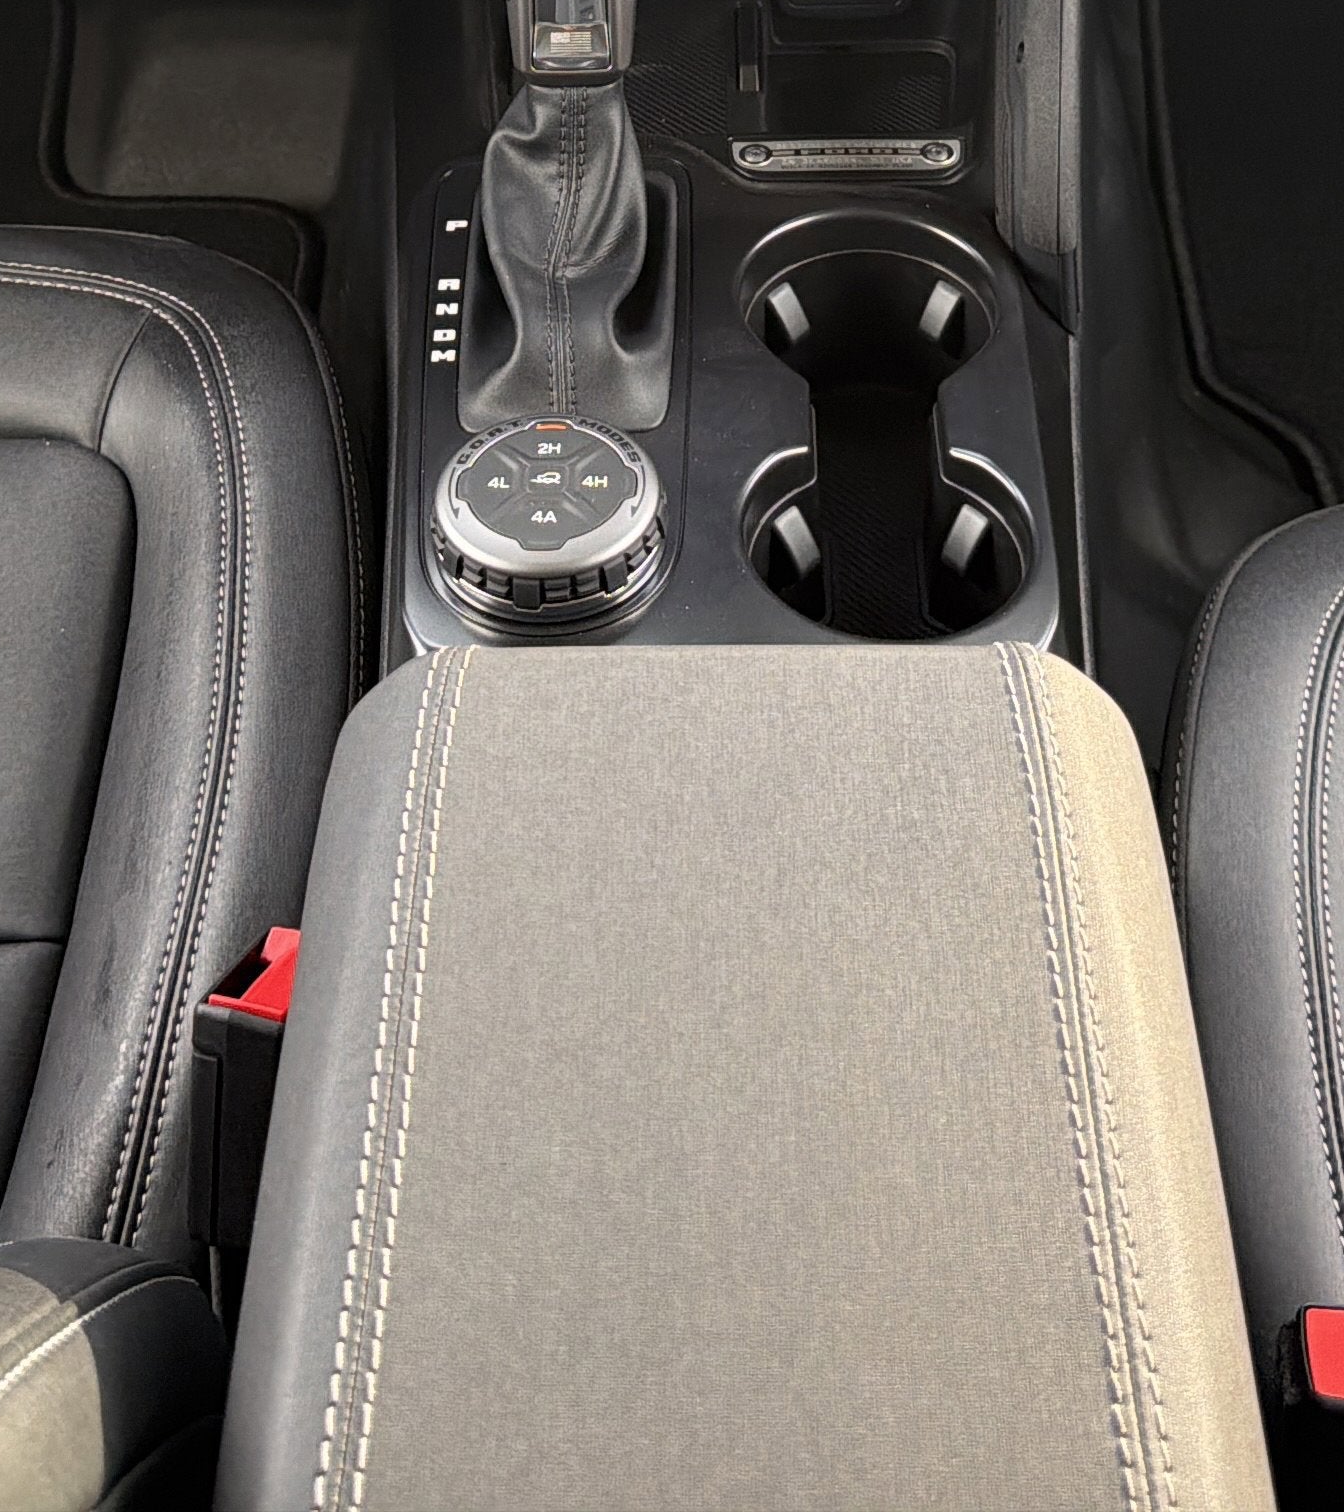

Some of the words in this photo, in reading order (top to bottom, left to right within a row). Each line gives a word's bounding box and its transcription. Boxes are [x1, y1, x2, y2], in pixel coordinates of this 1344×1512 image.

[445, 219, 469, 232] P
[435, 303, 459, 316] N
[430, 349, 456, 363] M
[578, 418, 642, 464] MODES
[537, 442, 562, 455] 2H
[487, 476, 510, 489] 4L
[581, 475, 608, 488] 4H
[530, 510, 557, 524] 4A
